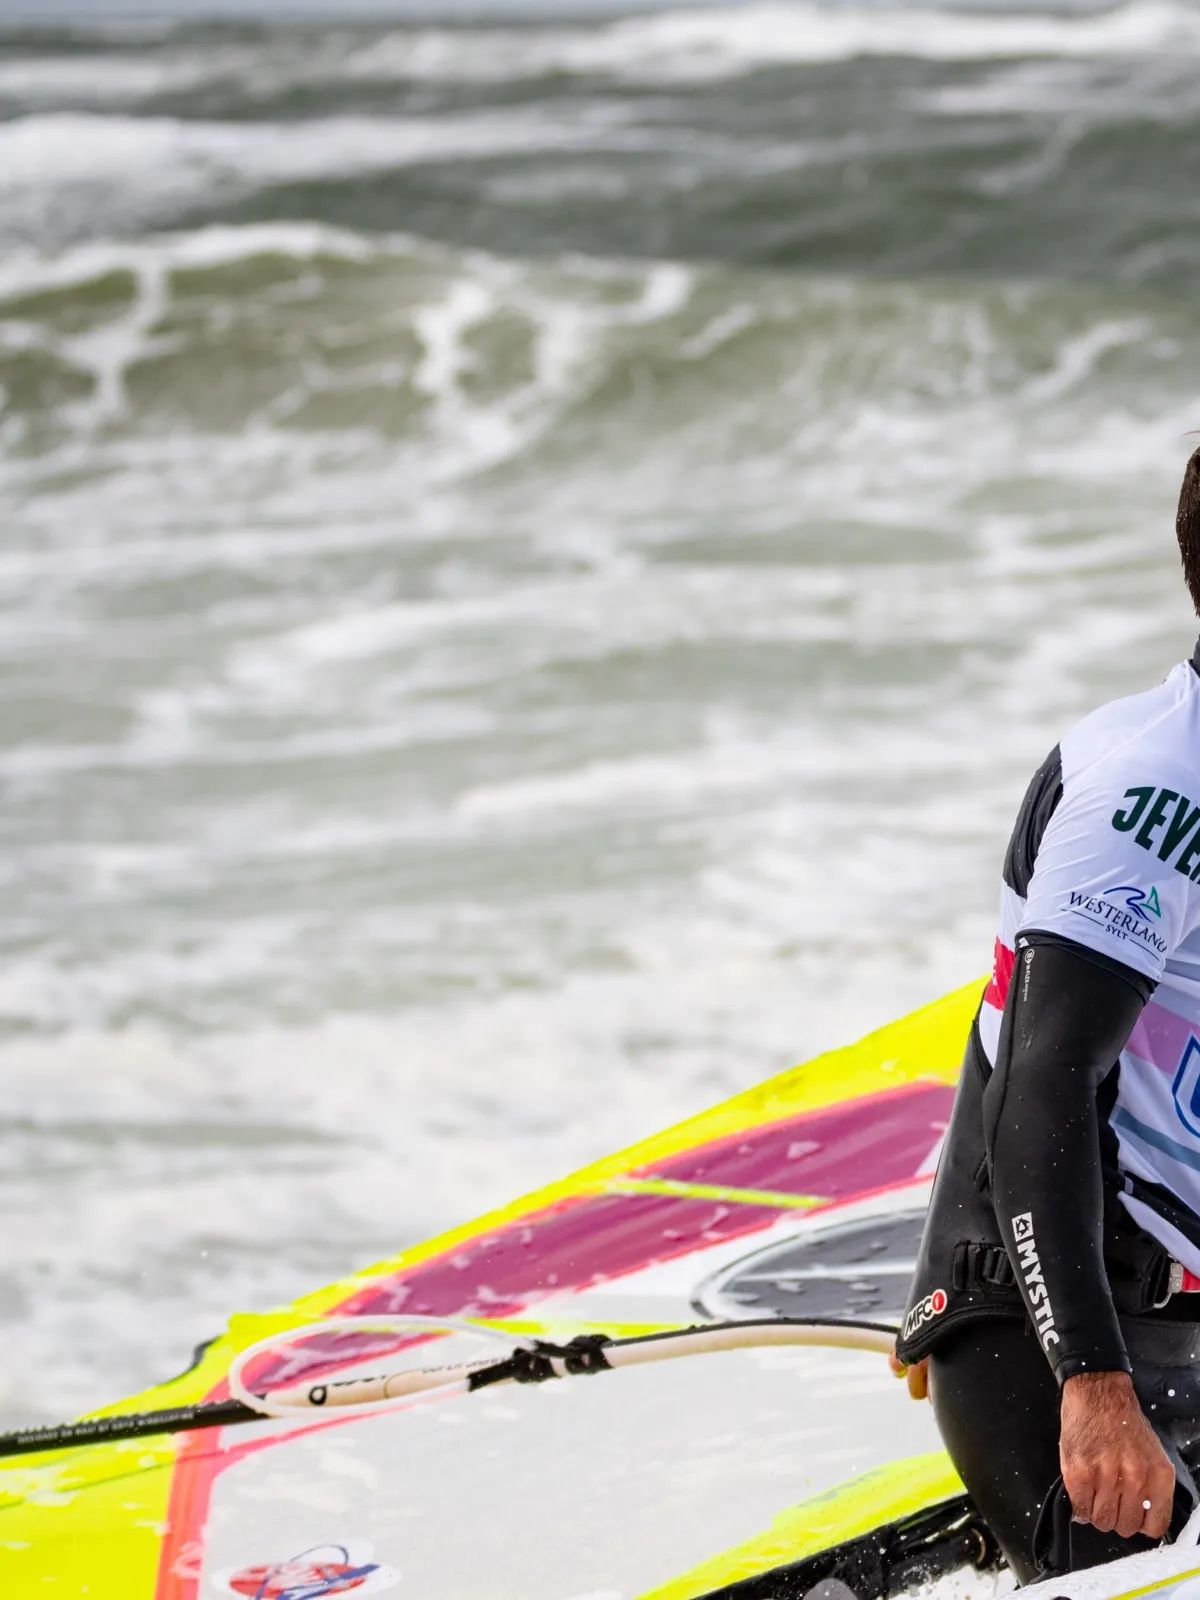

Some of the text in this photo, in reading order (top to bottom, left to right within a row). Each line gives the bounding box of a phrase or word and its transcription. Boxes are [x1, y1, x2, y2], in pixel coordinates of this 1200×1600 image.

[1105, 924, 1129, 940] SYLT
[1016, 1238, 1060, 1351] MYSTIC
[904, 1297, 934, 1340] MFC
